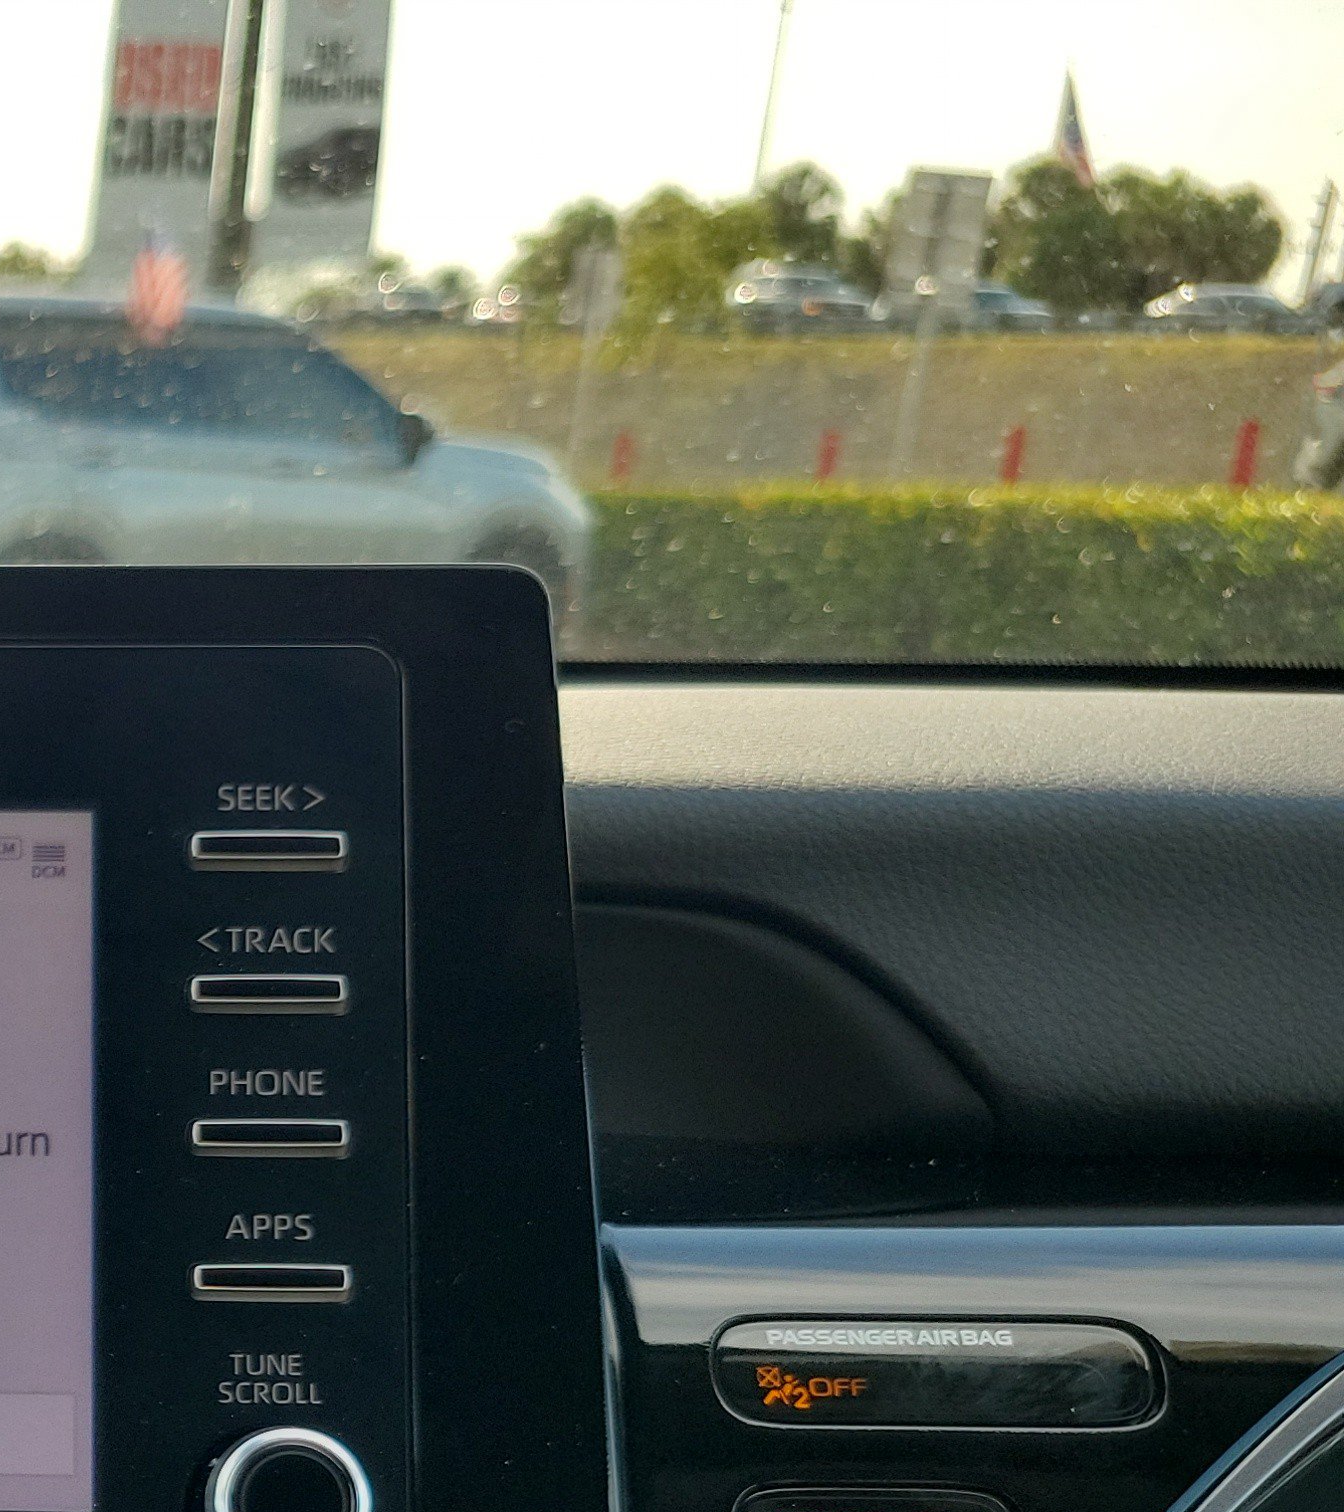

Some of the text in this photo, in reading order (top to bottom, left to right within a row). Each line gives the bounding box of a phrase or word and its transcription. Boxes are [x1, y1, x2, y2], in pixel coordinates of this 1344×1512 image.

[209, 1070, 325, 1096] PHONE
[225, 1214, 312, 1240] APPS
[765, 1329, 915, 1346] PASSENGER
[229, 1354, 303, 1376] TUNE
[218, 1382, 322, 1404] SCROLL
[808, 1376, 868, 1398] OFF
